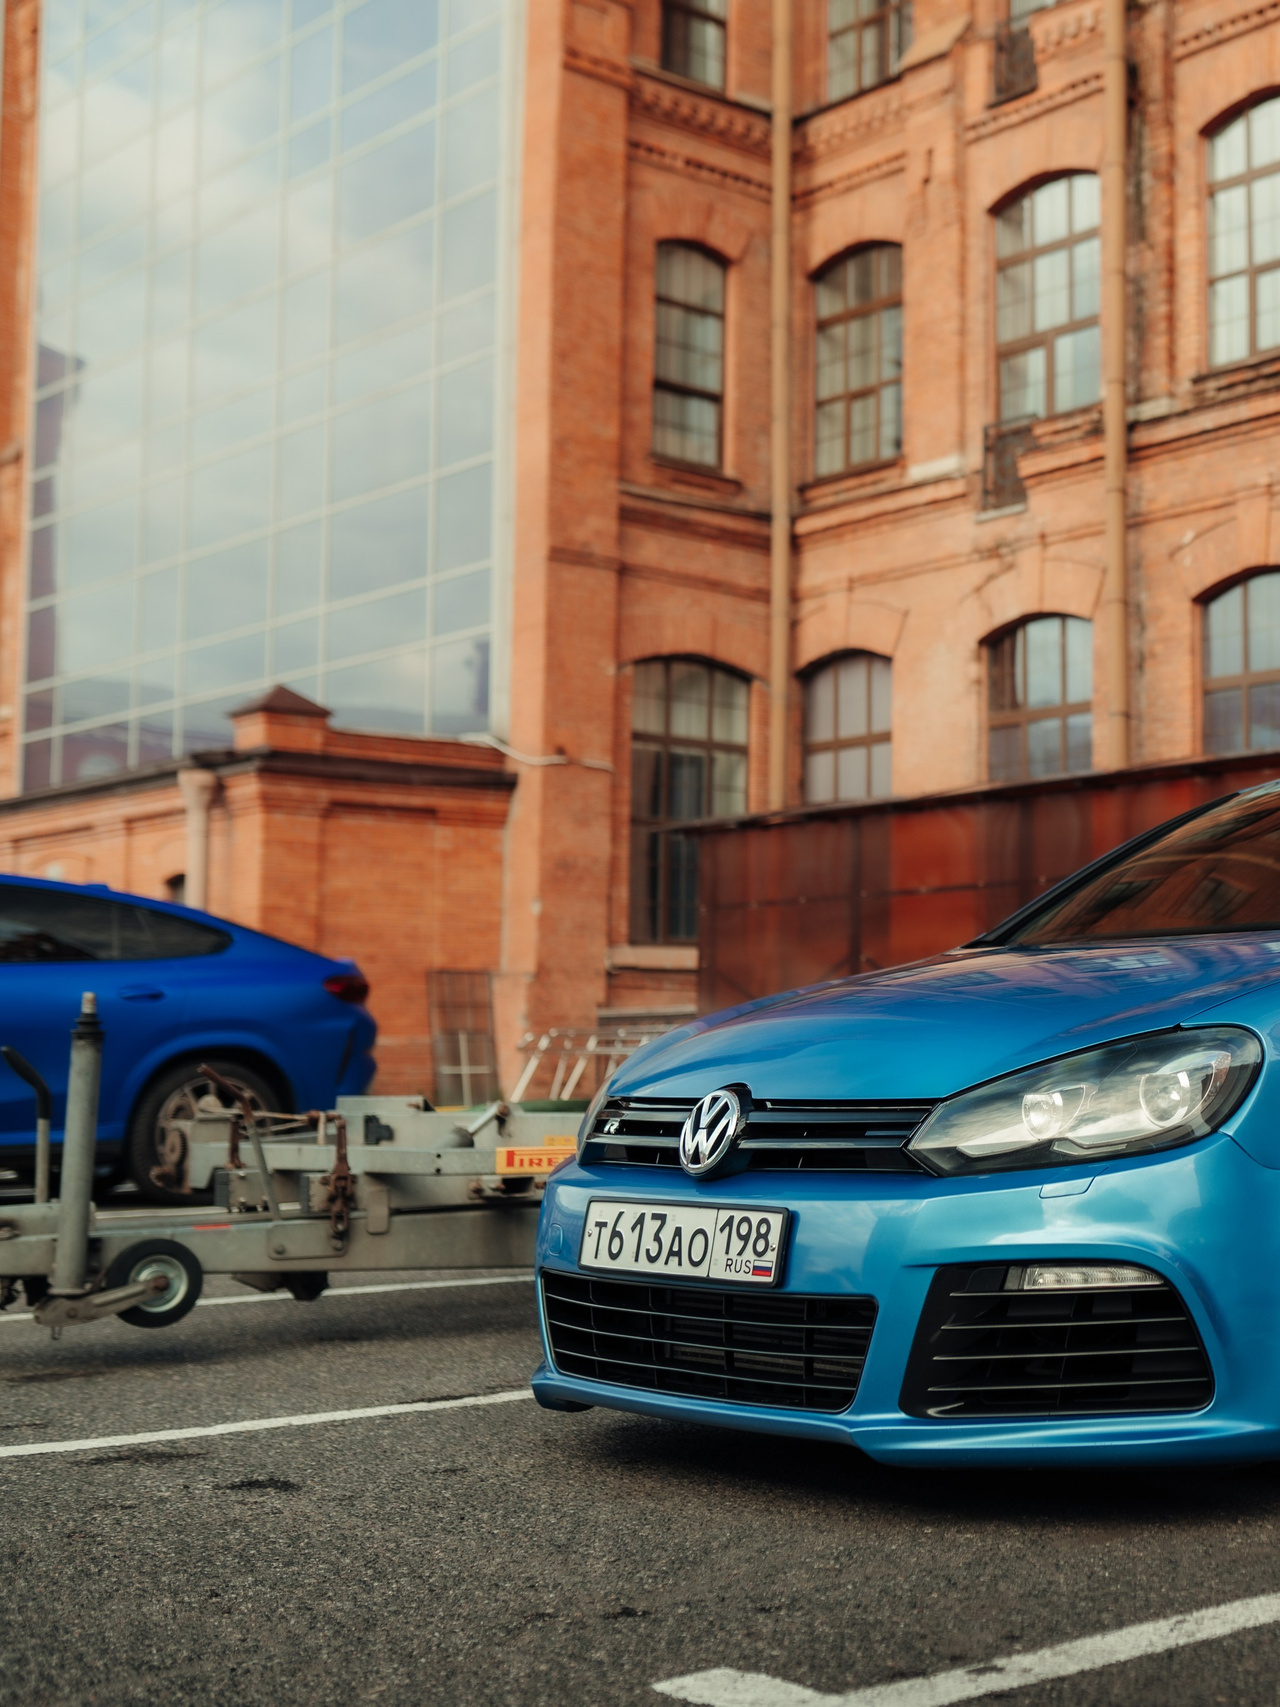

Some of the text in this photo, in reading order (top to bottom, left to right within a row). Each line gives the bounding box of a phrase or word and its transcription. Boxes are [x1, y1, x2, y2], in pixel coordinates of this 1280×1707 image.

[603, 1119, 621, 1135] R
[506, 1149, 573, 1168] PIRE
[719, 1214, 772, 1258] 198
[724, 1257, 751, 1275] RUS
